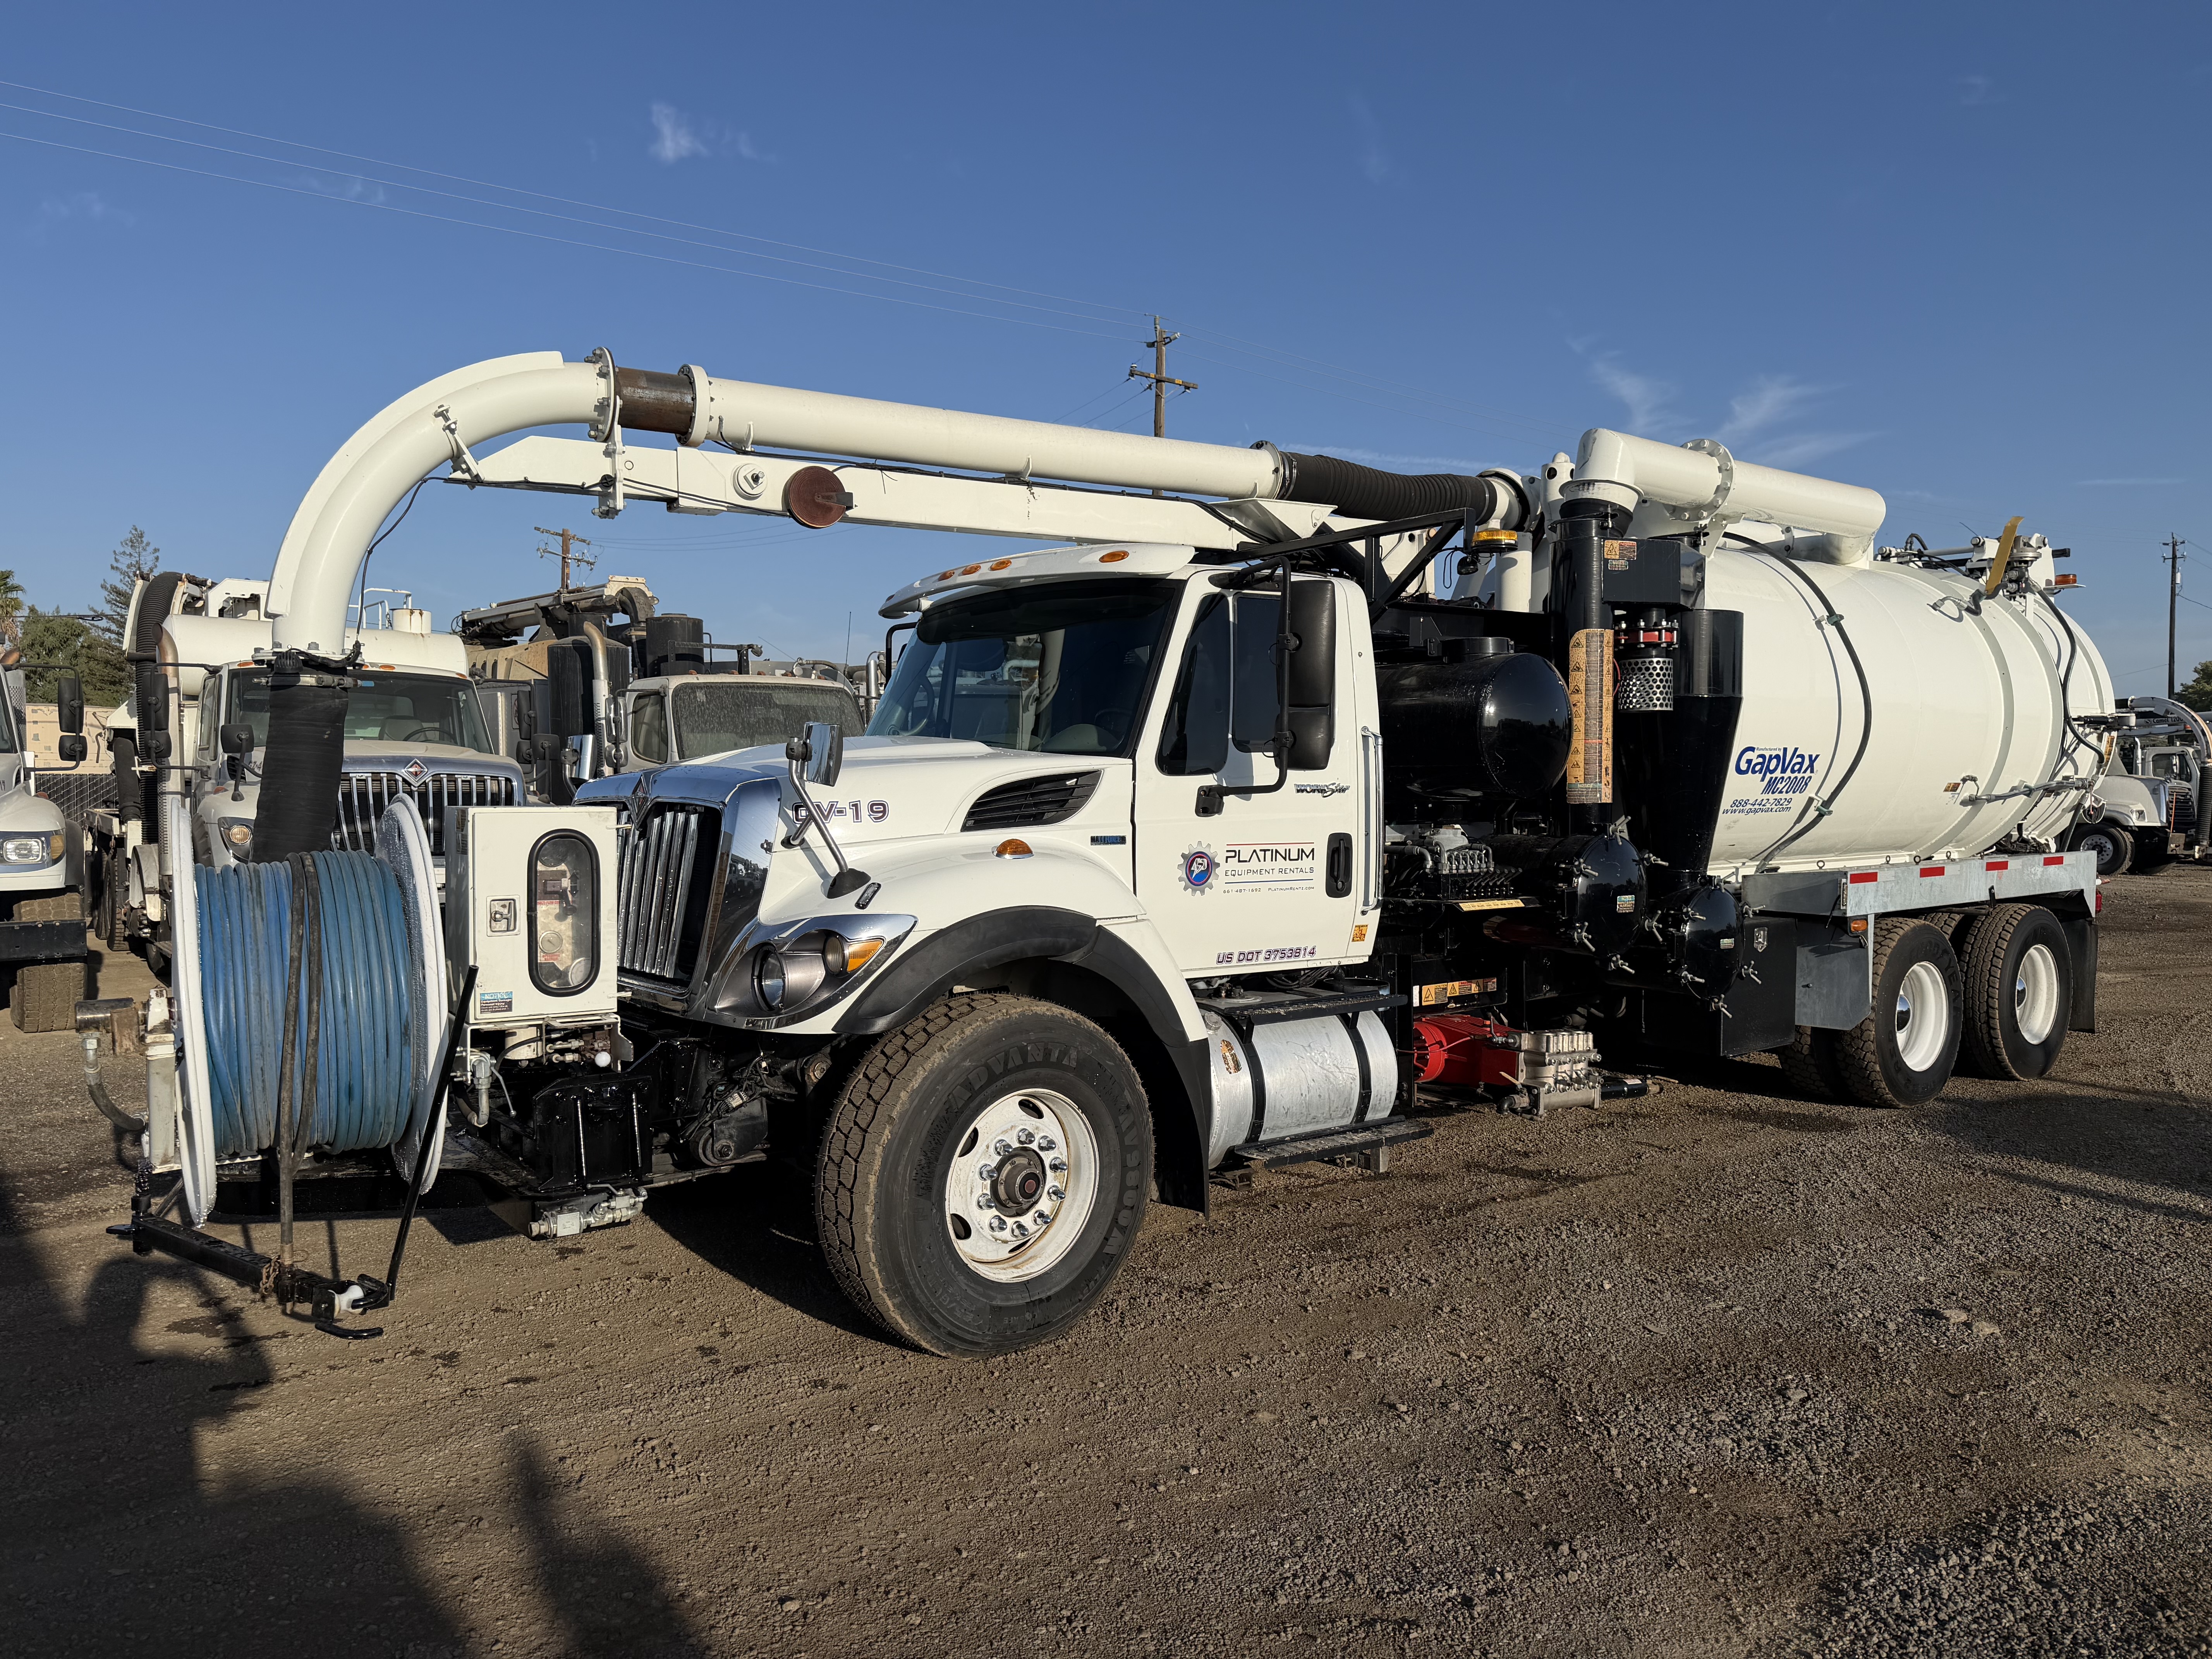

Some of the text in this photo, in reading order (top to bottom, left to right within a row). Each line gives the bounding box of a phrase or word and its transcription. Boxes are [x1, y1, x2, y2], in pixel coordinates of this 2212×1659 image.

[1735, 746, 1820, 782] GapVax
[1760, 776, 1812, 794] MC2008
[1730, 798, 1792, 807] 888-442-7829
[1722, 807, 1791, 815] www.gapvax.com
[1225, 848, 1314, 863] PLATINUM
[1225, 869, 1275, 877] EQUIPMENT
[1216, 946, 1316, 964] US DOT 3753814
[947, 1042, 1078, 1112] ADVANTA
